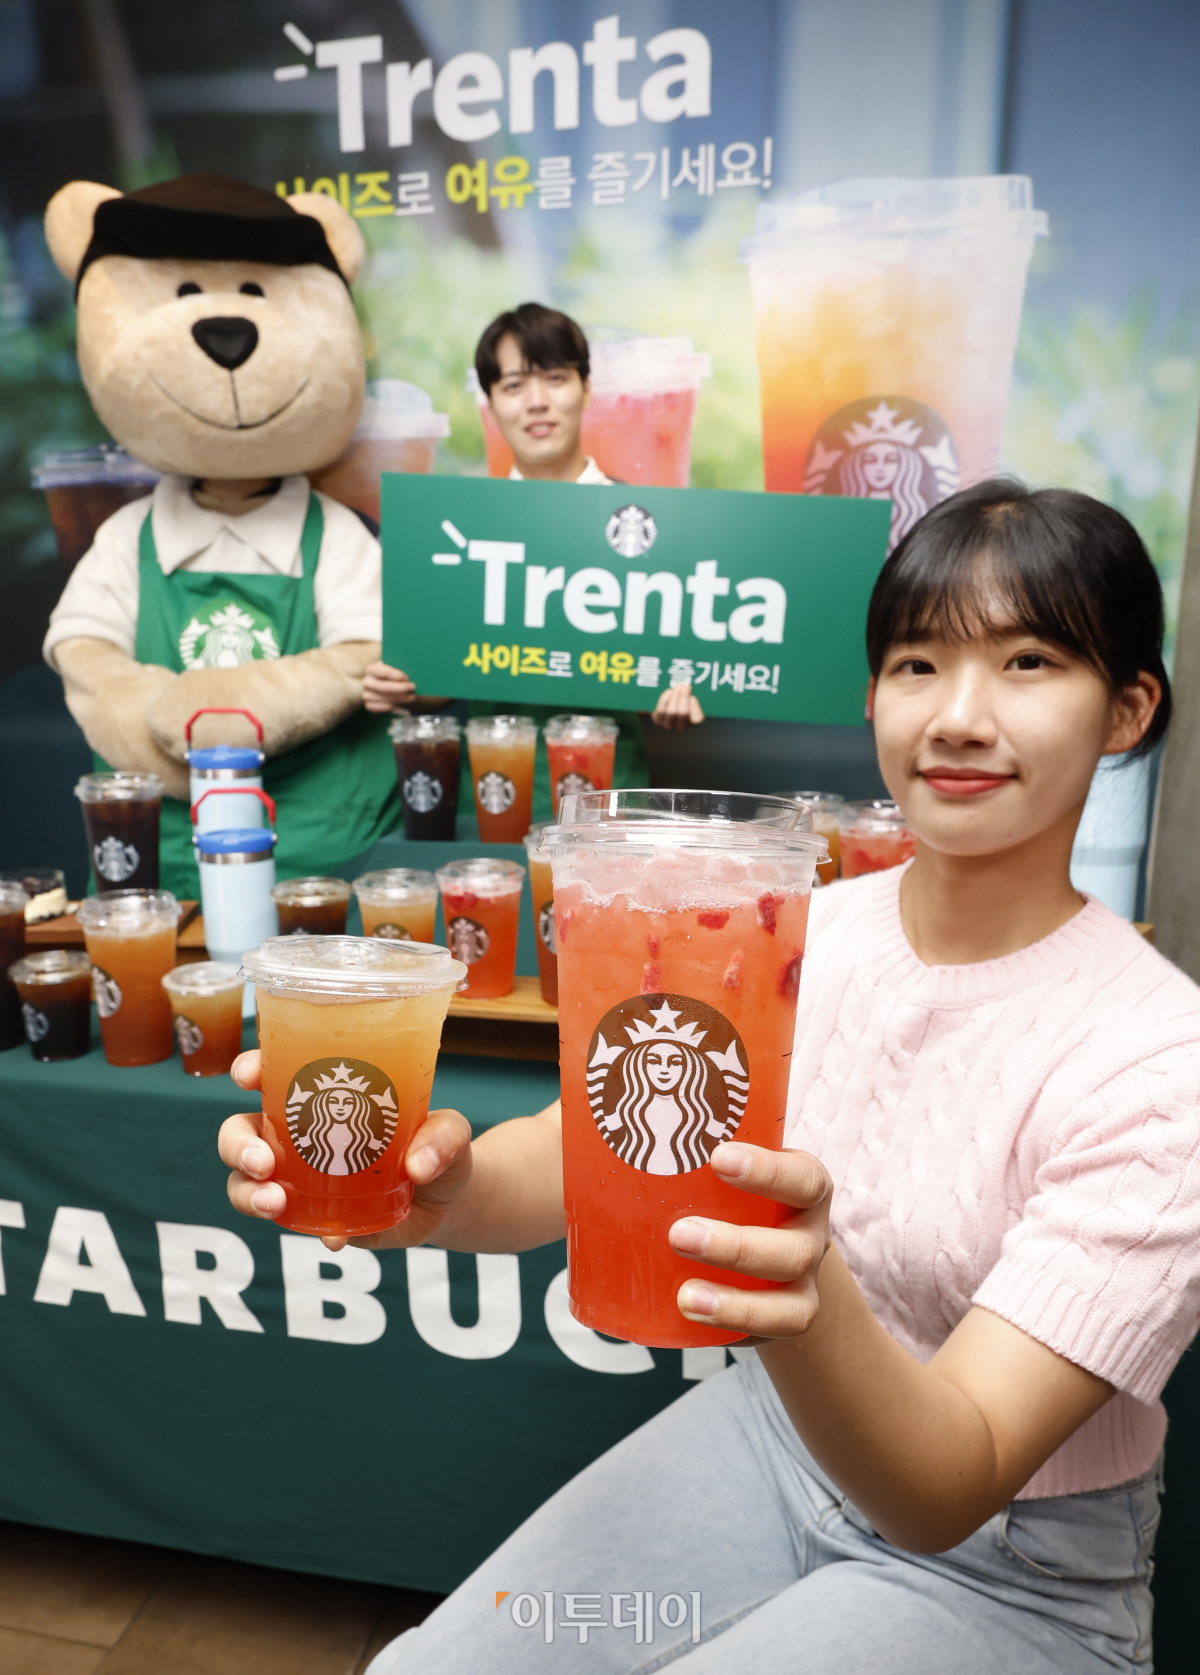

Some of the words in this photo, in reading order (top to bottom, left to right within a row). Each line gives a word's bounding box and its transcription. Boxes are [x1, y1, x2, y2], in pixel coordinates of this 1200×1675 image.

[316, 15, 712, 153] Trenta
[445, 156, 576, 213] 여유를
[587, 137, 774, 206] 즐기세요!
[468, 539, 787, 644] Trenta
[462, 642, 574, 678] 사이즈로
[579, 650, 662, 688] 여유를
[667, 658, 781, 694] 즐기세요!
